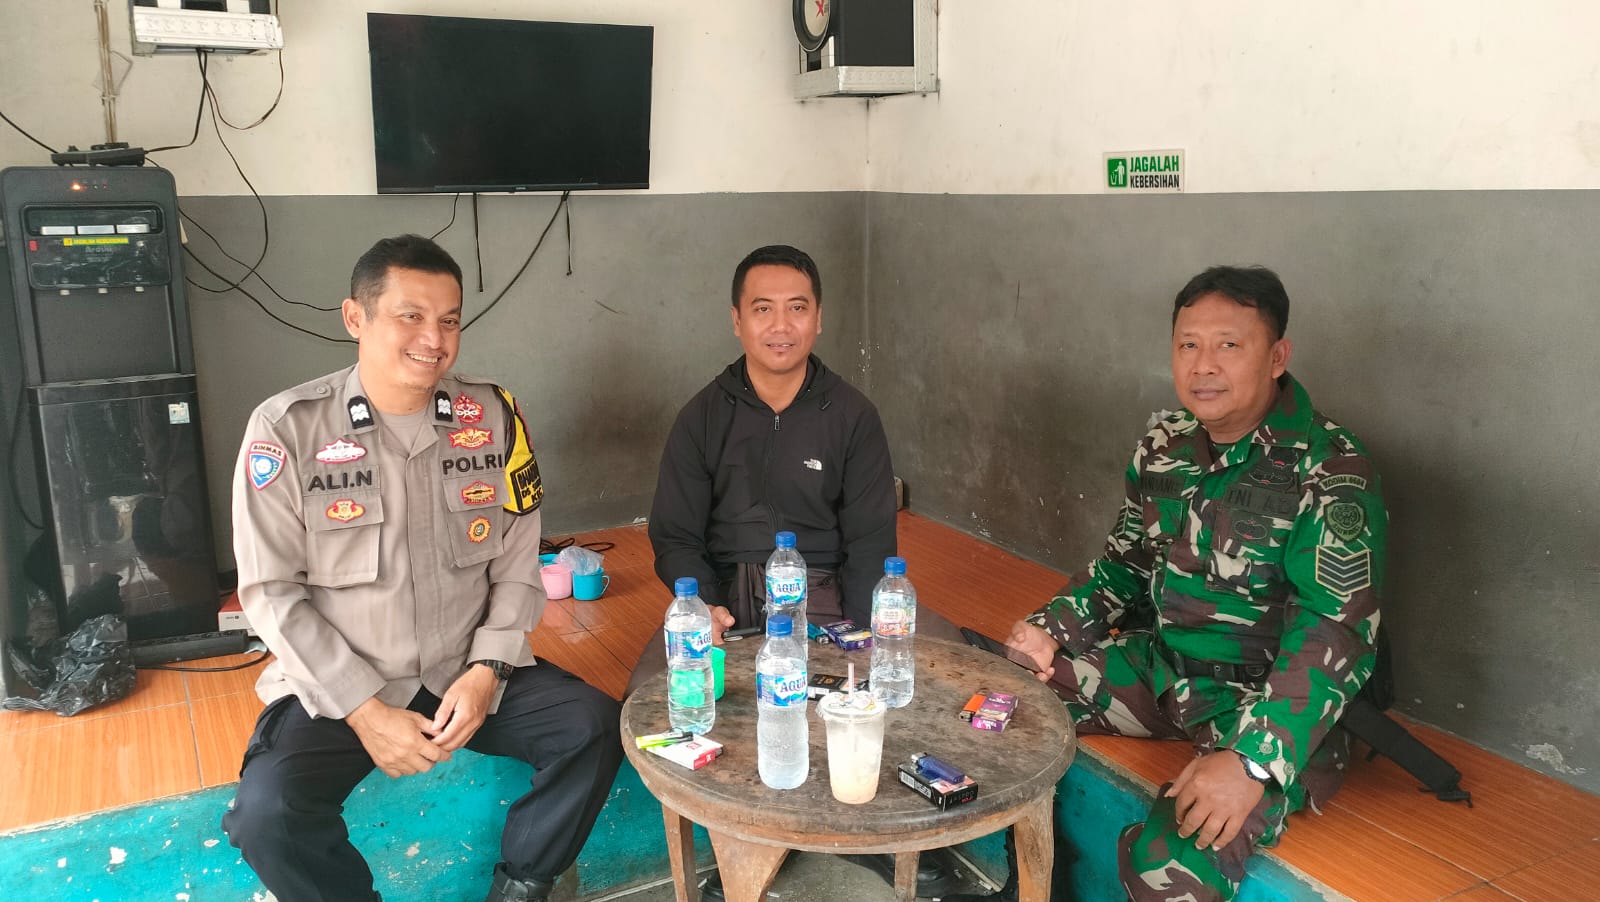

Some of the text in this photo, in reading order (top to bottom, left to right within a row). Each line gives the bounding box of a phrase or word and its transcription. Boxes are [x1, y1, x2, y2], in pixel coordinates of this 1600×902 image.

[1130, 155, 1179, 172] JAGALAH
[1130, 174, 1180, 189] KEBERSIHAN
[253, 444, 283, 457] BINMAS
[442, 453, 503, 475] POLRI
[307, 469, 373, 492] ALI.N
[1228, 487, 1252, 507] TNI
[776, 582, 801, 595] AQUA
